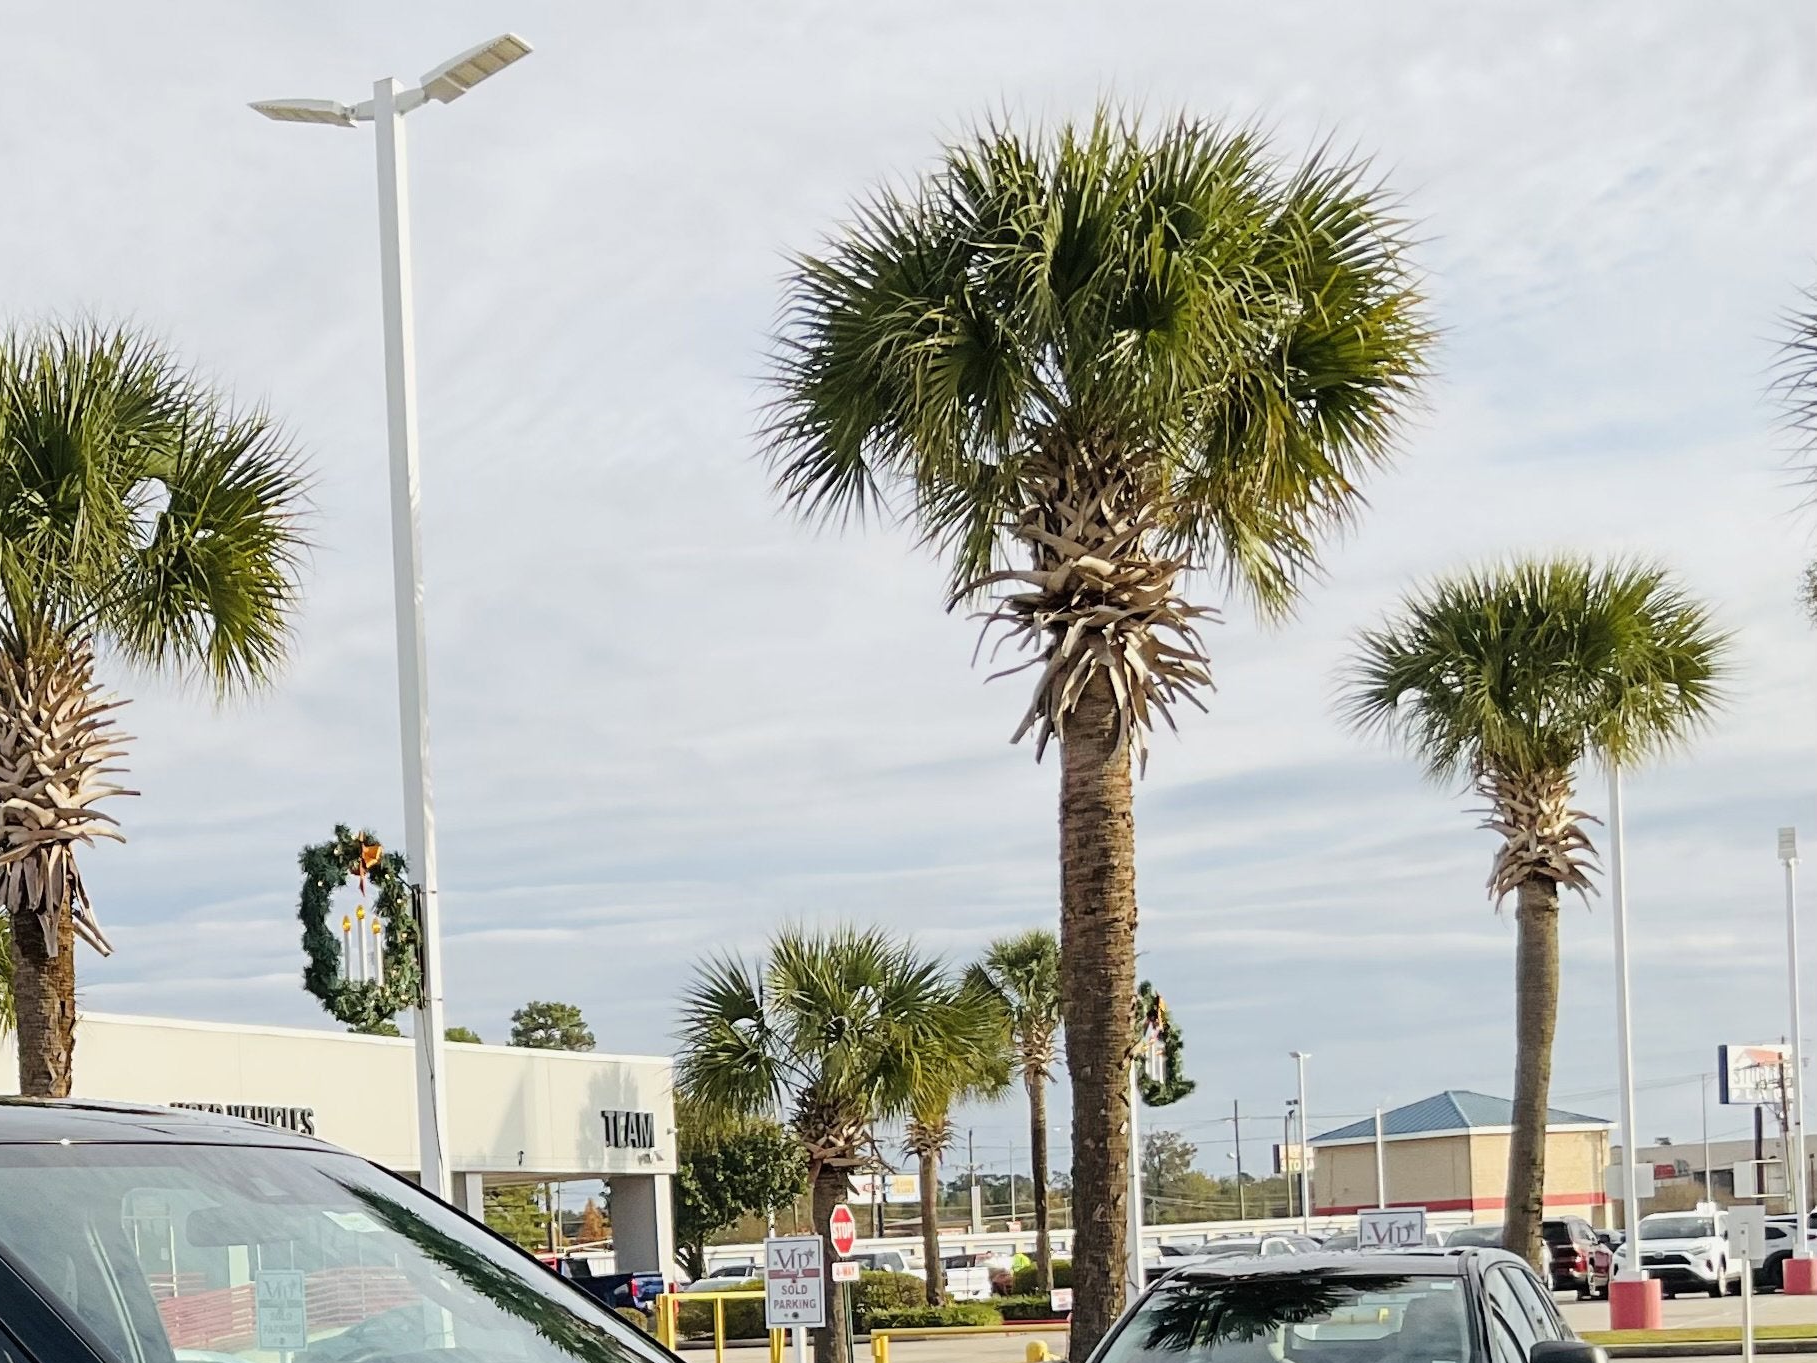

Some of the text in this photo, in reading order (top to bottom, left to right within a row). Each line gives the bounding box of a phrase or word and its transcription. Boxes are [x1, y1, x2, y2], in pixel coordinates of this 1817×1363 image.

[601, 1110, 655, 1149] TEAM
[832, 1221, 853, 1239] STOP
[781, 1284, 808, 1295] SOLD
[773, 1298, 816, 1309] PARKING
